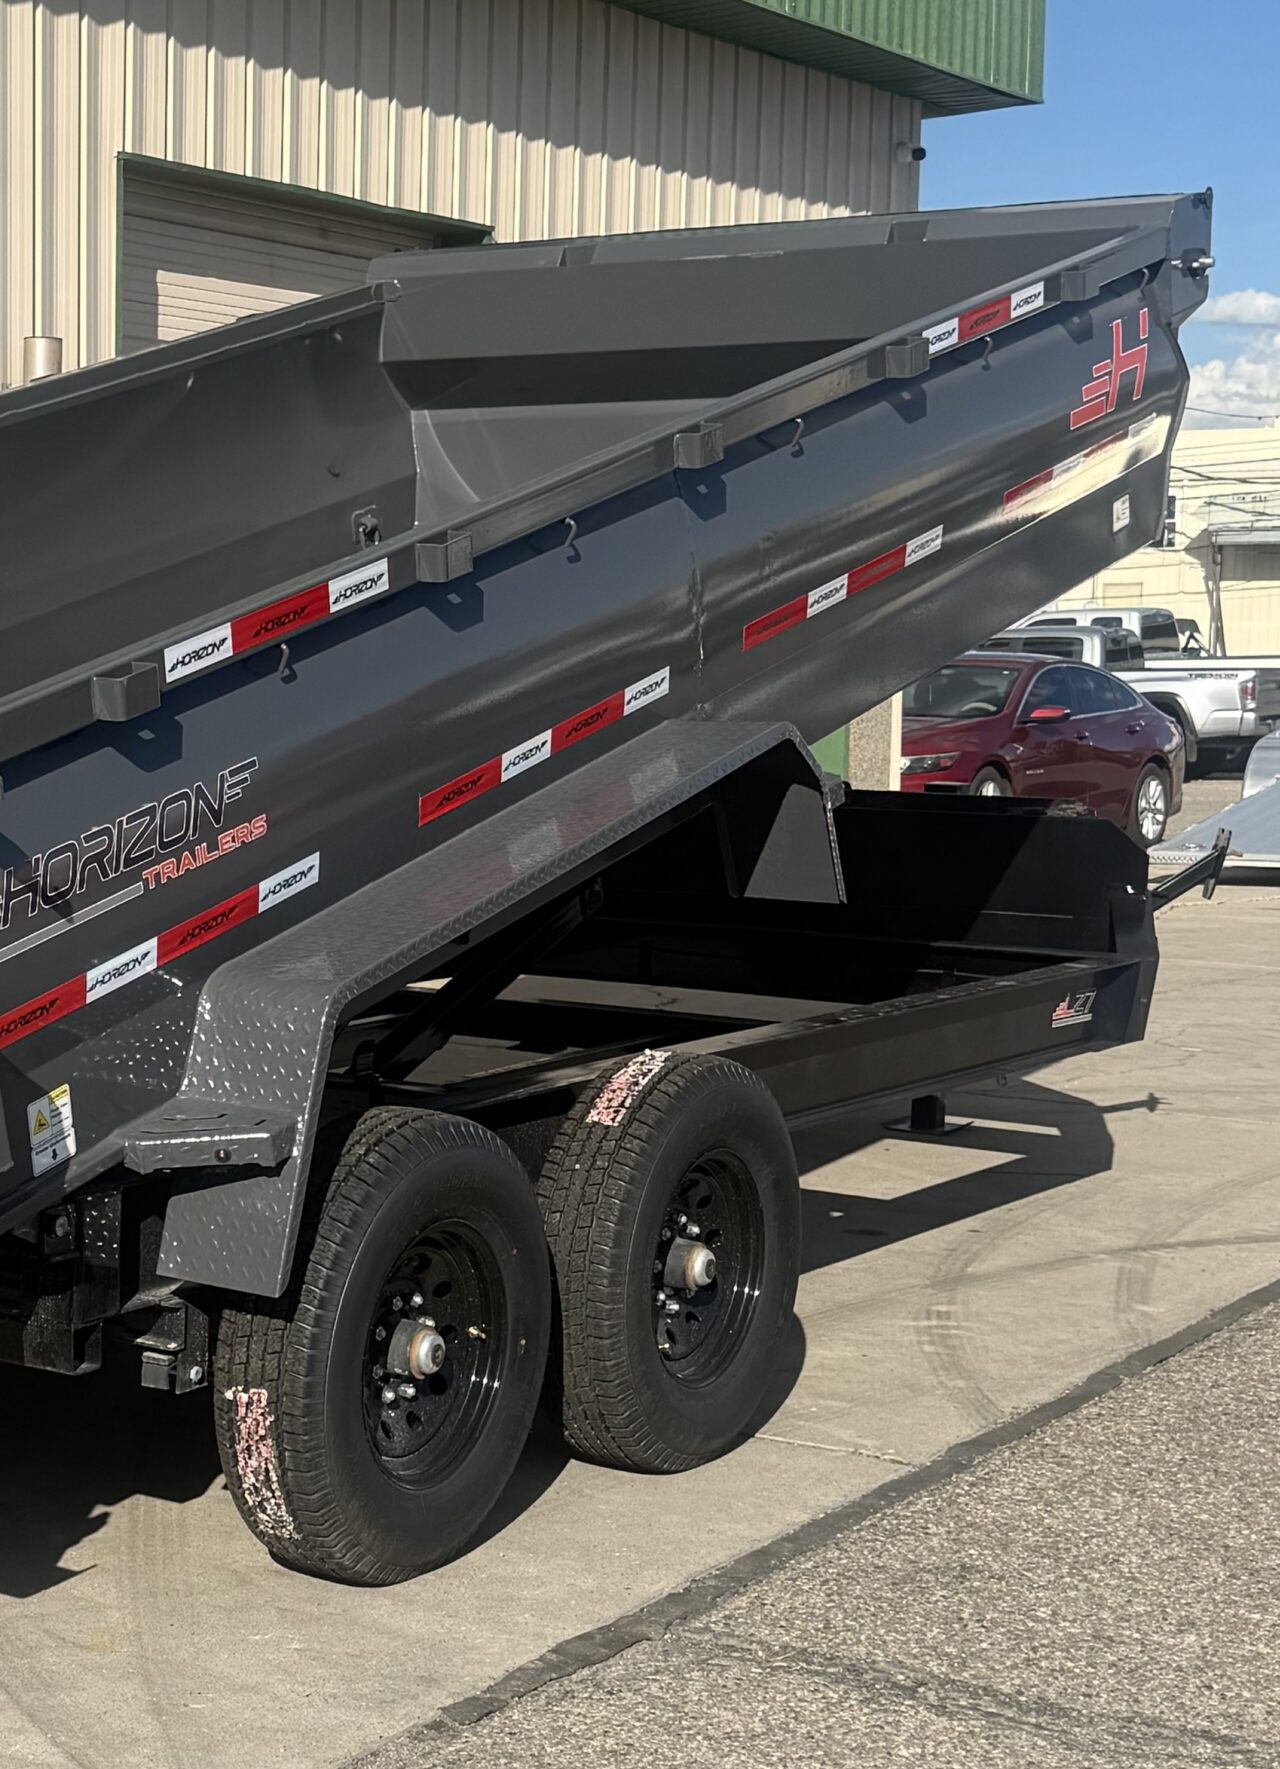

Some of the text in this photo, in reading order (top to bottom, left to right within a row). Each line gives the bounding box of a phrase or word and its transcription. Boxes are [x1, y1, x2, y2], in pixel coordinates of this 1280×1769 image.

[168, 573, 385, 673] HORIZON HORIZON HORIZON
[436, 676, 667, 809] HORIZON HORIZON HORIZON HORIZON
[143, 814, 267, 890] TRAILERS
[86, 951, 151, 994] HORIZON
[177, 904, 239, 947] HORIZON
[261, 864, 317, 902] HORIZON
